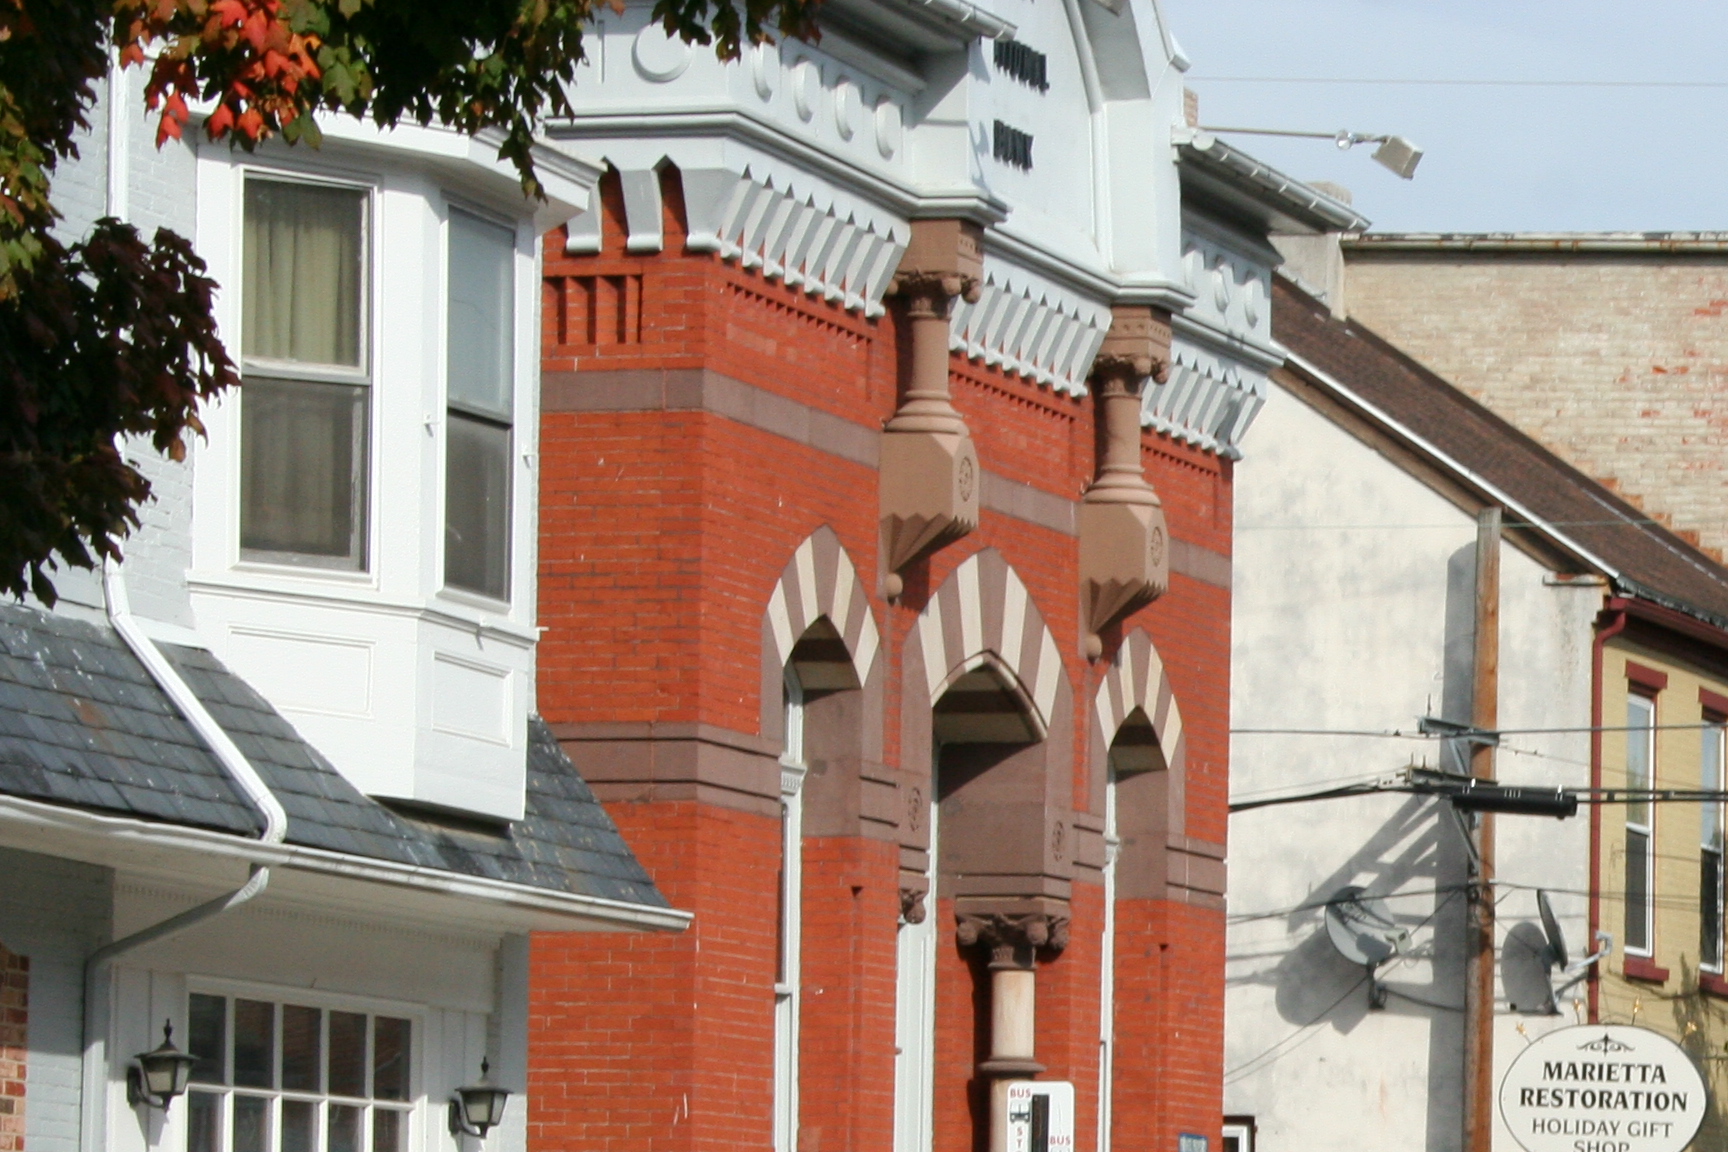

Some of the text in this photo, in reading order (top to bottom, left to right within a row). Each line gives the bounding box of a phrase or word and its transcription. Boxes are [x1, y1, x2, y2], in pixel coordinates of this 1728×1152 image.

[1542, 1061, 1667, 1083] MARIETTA
[1010, 1088, 1031, 1098] BUS
[1519, 1087, 1688, 1112] RESTORATION
[1532, 1118, 1674, 1138] HOLIDAY GIFT
[1049, 1135, 1071, 1145] BUS
